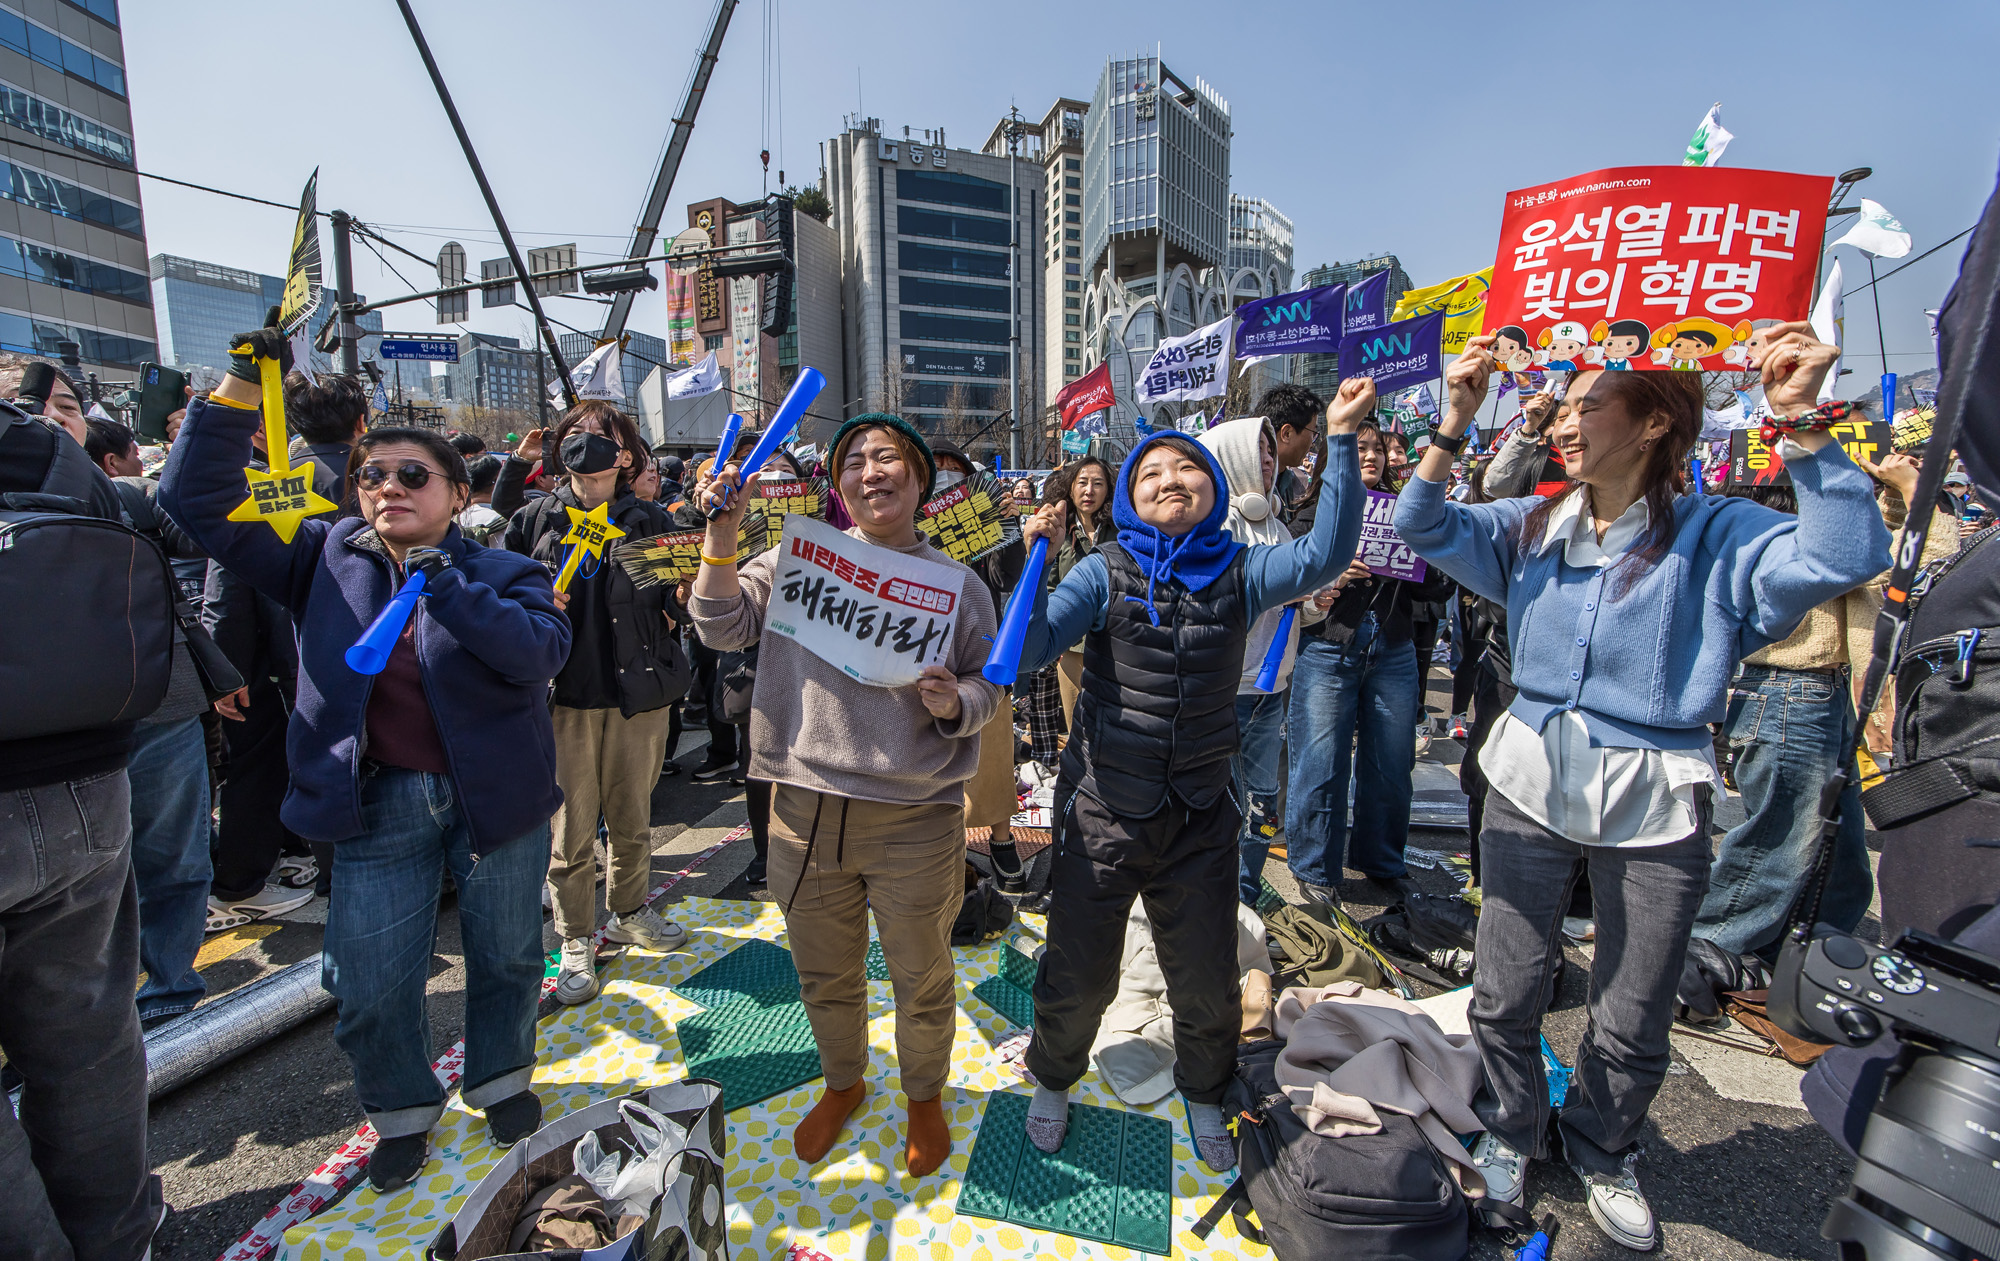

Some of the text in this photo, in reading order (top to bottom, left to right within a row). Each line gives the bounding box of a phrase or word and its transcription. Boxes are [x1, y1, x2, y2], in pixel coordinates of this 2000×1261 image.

[909, 145, 947, 168] 동일
[1513, 177, 1651, 208] 나눔문화 www.nanum.com
[1513, 202, 1801, 272] 윤석열 파면
[1356, 257, 1389, 271] 서울경제
[1522, 259, 1762, 323] 빛의 혁명
[420, 343, 456, 353] 인사동길
[252, 476, 307, 502] 파면
[258, 496, 306, 515] 윤석열
[917, 491, 993, 538] 윤석열을
[573, 524, 605, 546] 파면
[791, 536, 952, 611] 내란동조 국민의힘
[781, 569, 950, 664] 해체하라!
[1815, 1002, 1833, 1013] OFF
[1824, 994, 1838, 1003] ON
[1033, 1116, 1051, 1124] NEPA
